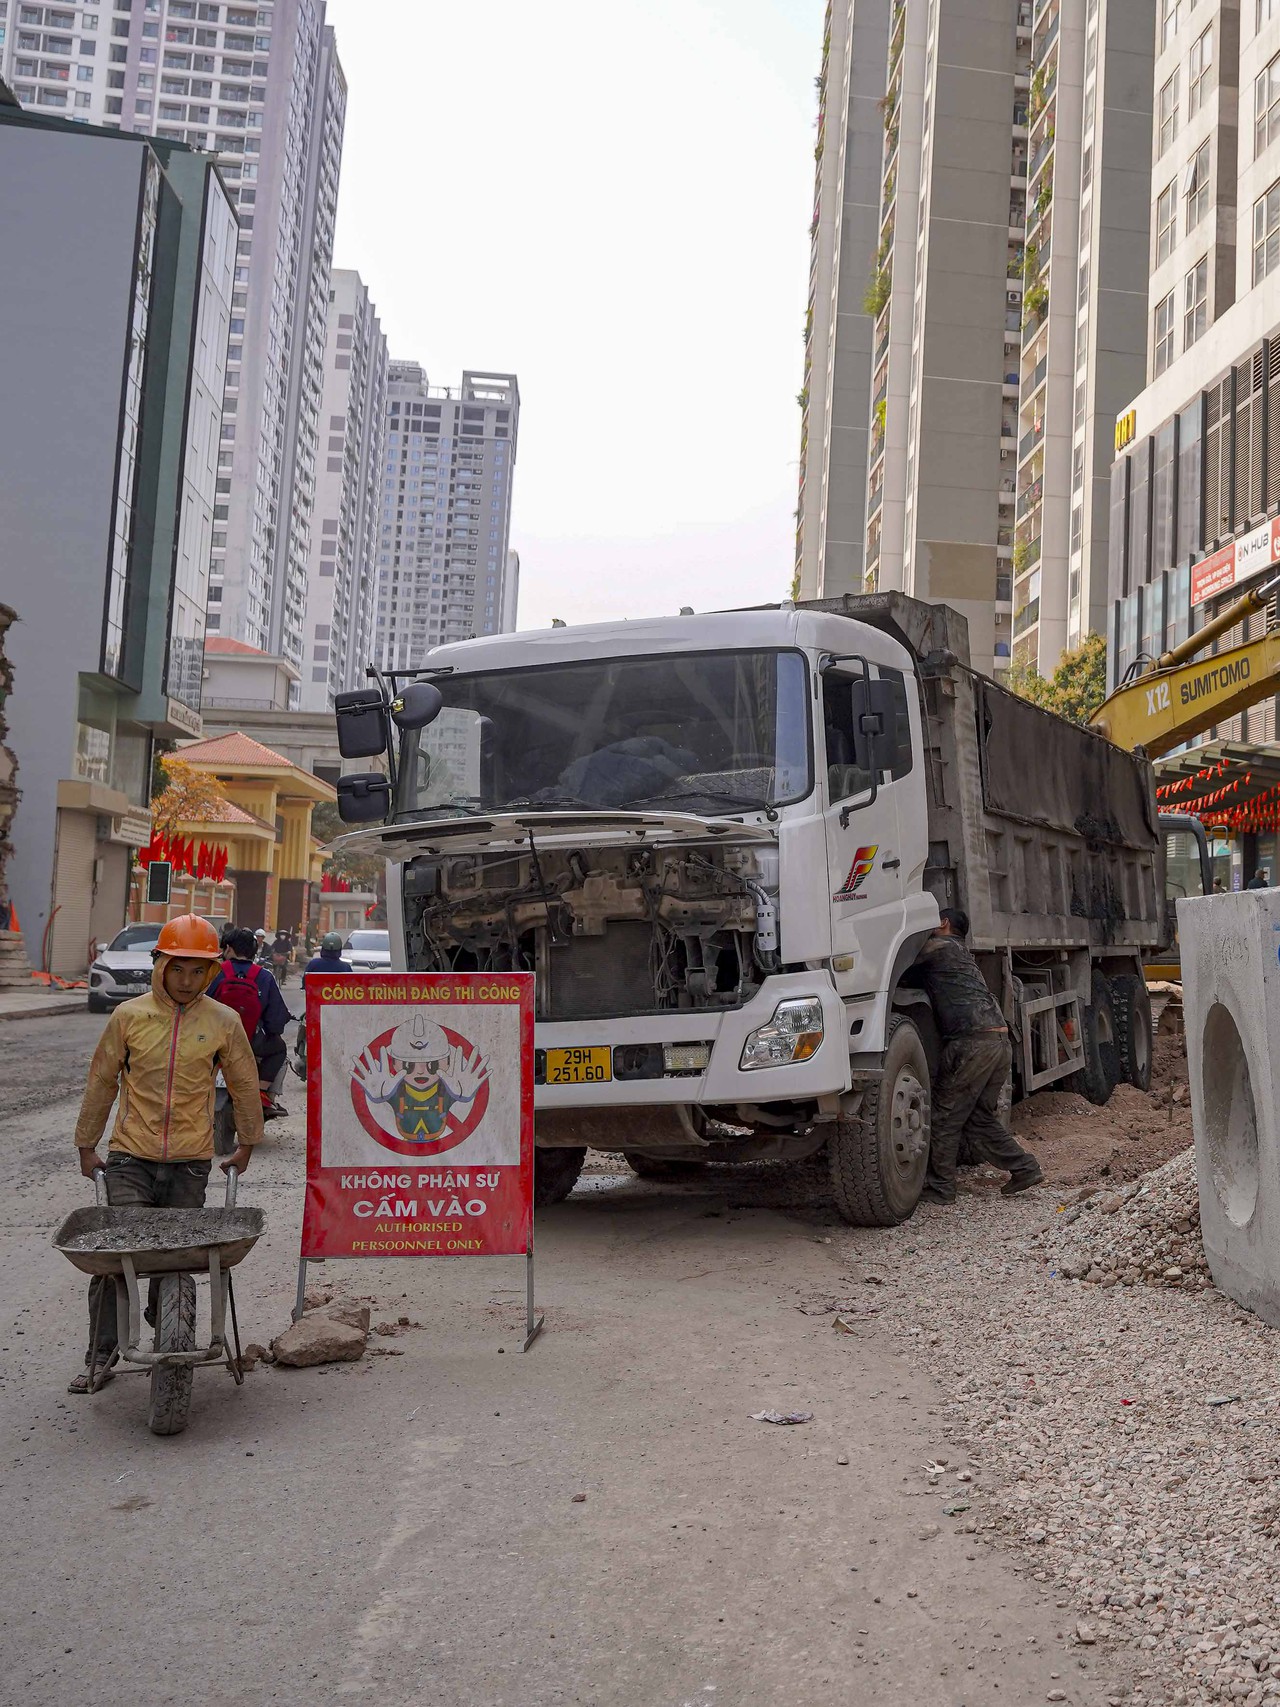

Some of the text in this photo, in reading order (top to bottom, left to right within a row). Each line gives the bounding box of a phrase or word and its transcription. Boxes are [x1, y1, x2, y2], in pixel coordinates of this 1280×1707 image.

[1251, 533, 1269, 554] HUB
[1181, 657, 1251, 705] SUMITOMO
[1146, 681, 1171, 717] X12
[321, 983, 521, 1001] CÔNG TRÌNH ĐANG THI CÔNG
[564, 1049, 592, 1065] 29H
[553, 1065, 604, 1082] 251.60
[341, 1170, 501, 1192] KHÔNG PHẬN SỰ
[353, 1193, 487, 1218] CẤM VÀO
[374, 1222, 463, 1233] AUTHORISED
[352, 1239, 484, 1251] PERSOONNEL ONLY
